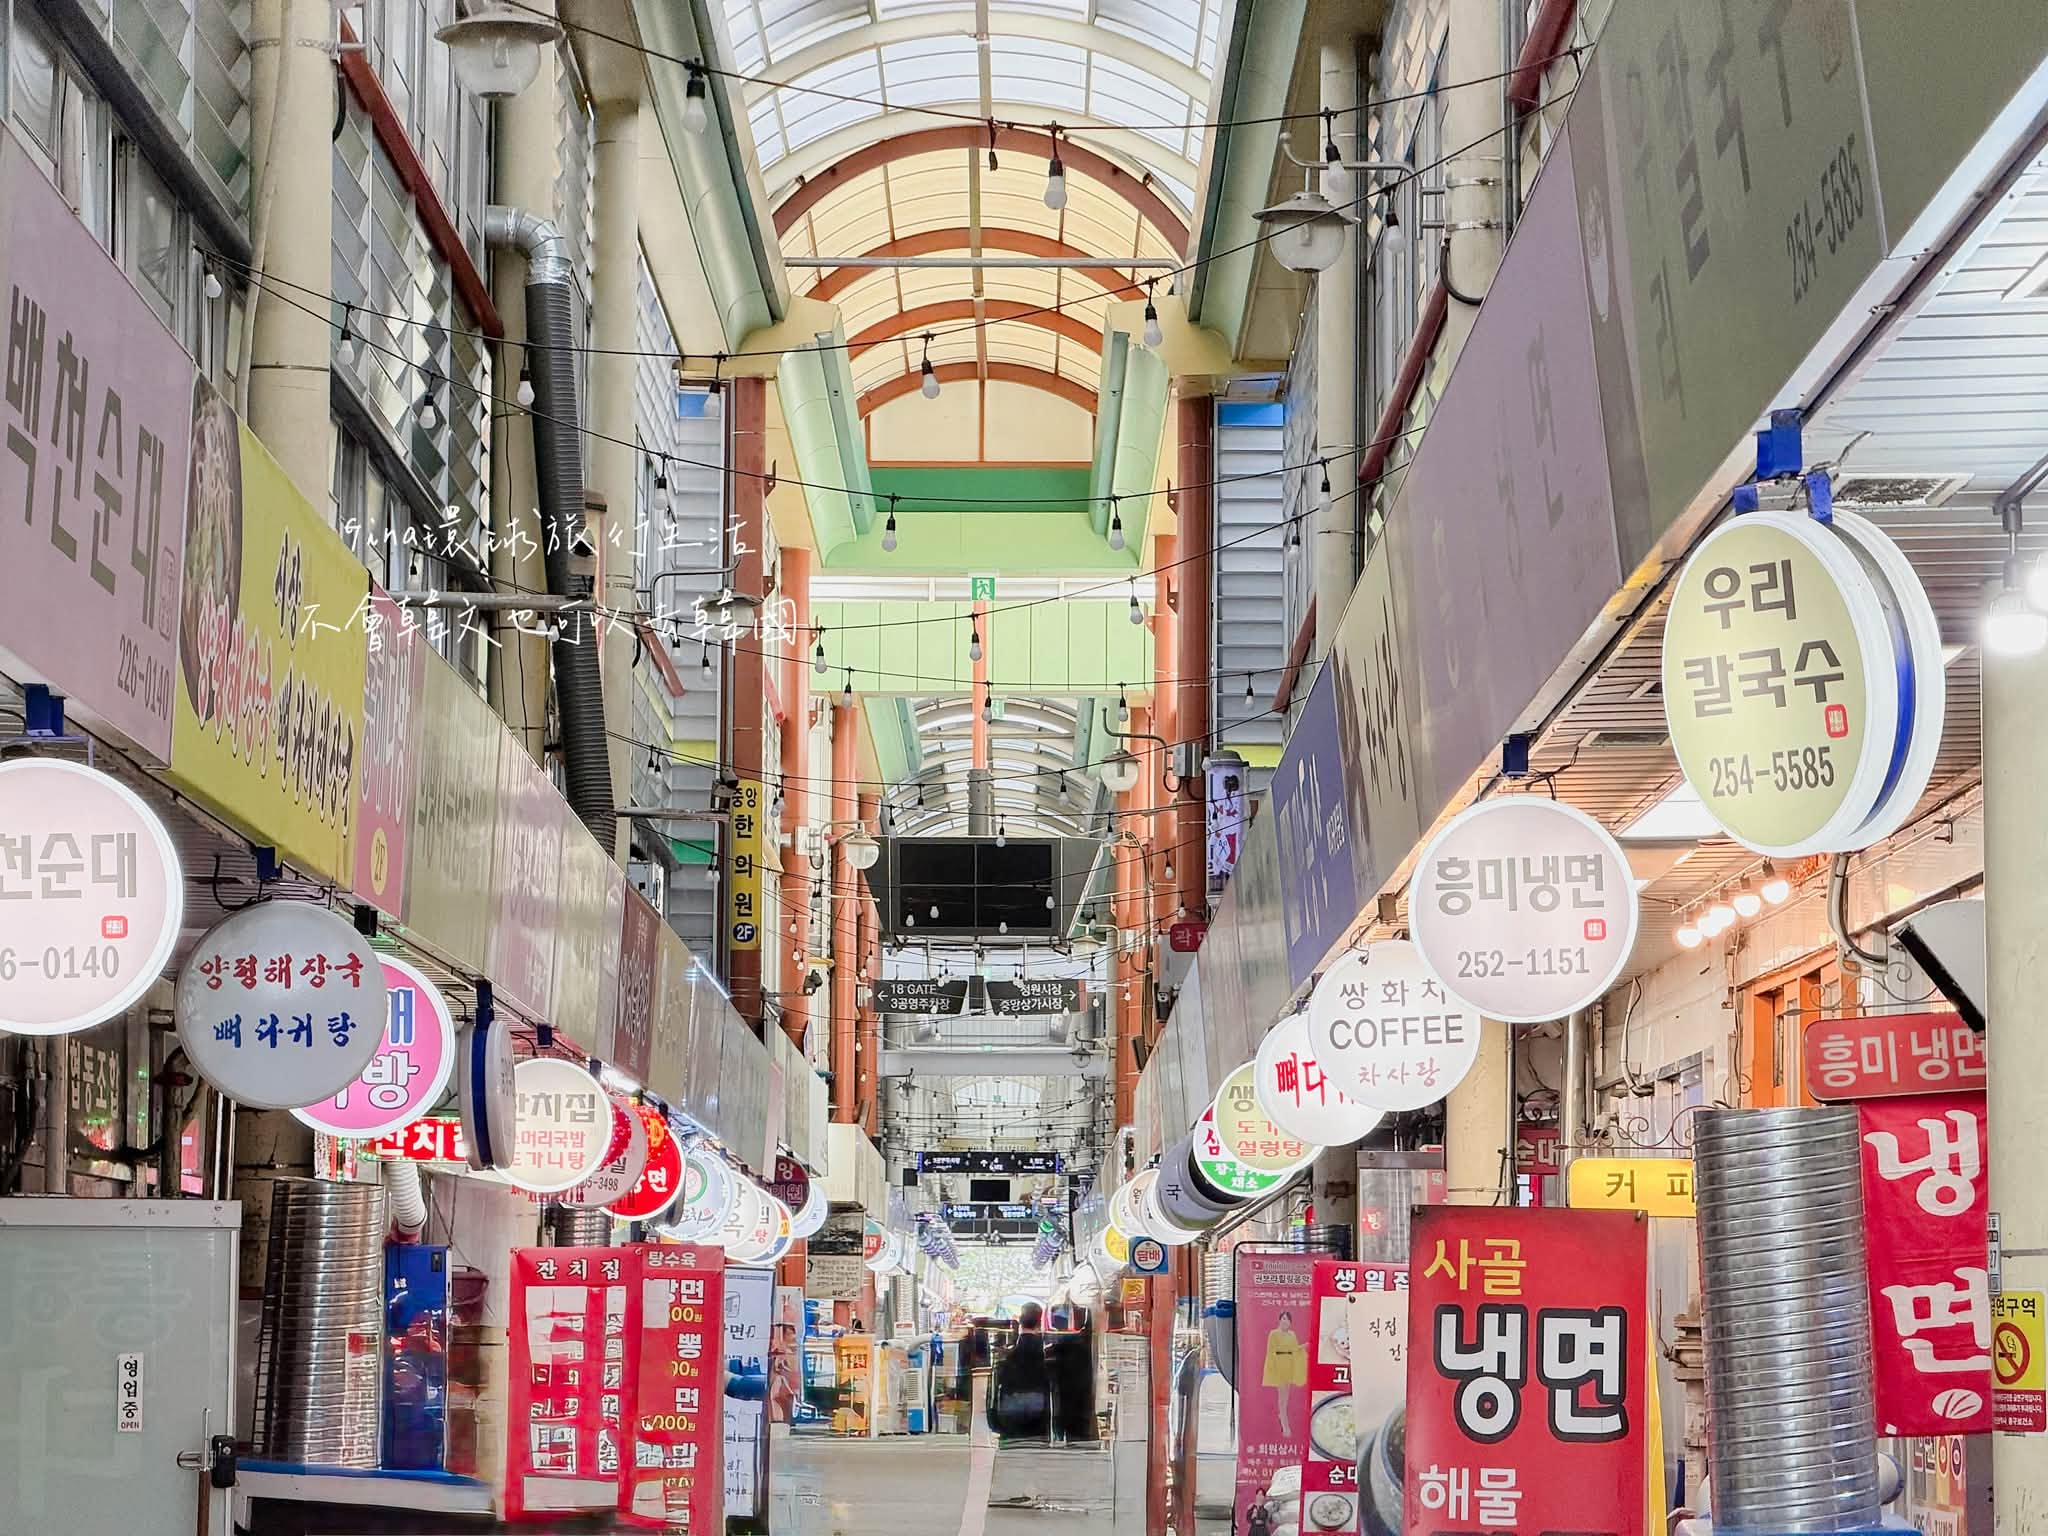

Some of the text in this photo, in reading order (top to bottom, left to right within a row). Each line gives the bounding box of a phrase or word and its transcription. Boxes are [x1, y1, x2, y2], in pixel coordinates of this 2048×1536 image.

[1785, 132, 1865, 306] 254-5585
[6, 284, 165, 630] 백천순대
[1703, 558, 1797, 630] 우리
[117, 633, 170, 721] 226-0140
[1683, 639, 1845, 718] 칼국수
[1709, 746, 1835, 798] 254-5585
[734, 814, 754, 918] 한의원
[1435, 854, 1605, 916] 흥미냉면
[735, 925, 754, 942] 2F
[200, 953, 364, 990] 양평해장국
[890, 983, 937, 994] 18 GATE
[1457, 947, 1591, 979] 252-1151
[890, 998, 950, 1010] 3공영주차장
[1000, 997, 1063, 1011] 중앙상가시장
[1329, 1014, 1465, 1050] COFFEE
[1276, 1051, 1354, 1108] 뼈다
[1359, 1058, 1441, 1088] 차사랑
[1818, 1033, 1898, 1087] 흥미
[375, 1123, 464, 1157] 잔치
[516, 1131, 587, 1149] 머리국밥
[1237, 1140, 1303, 1158] 설렁탕
[648, 1251, 697, 1268] 탕수육
[1424, 1239, 1527, 1295] 사골
[1864, 1108, 1992, 1374] 냉면
[536, 1259, 621, 1281] 잔치집
[123, 1360, 140, 1419] 영업중
[1435, 1303, 1629, 1444] 냉면
[120, 1421, 140, 1430] OPEN
[1419, 1465, 1523, 1527] 해물
